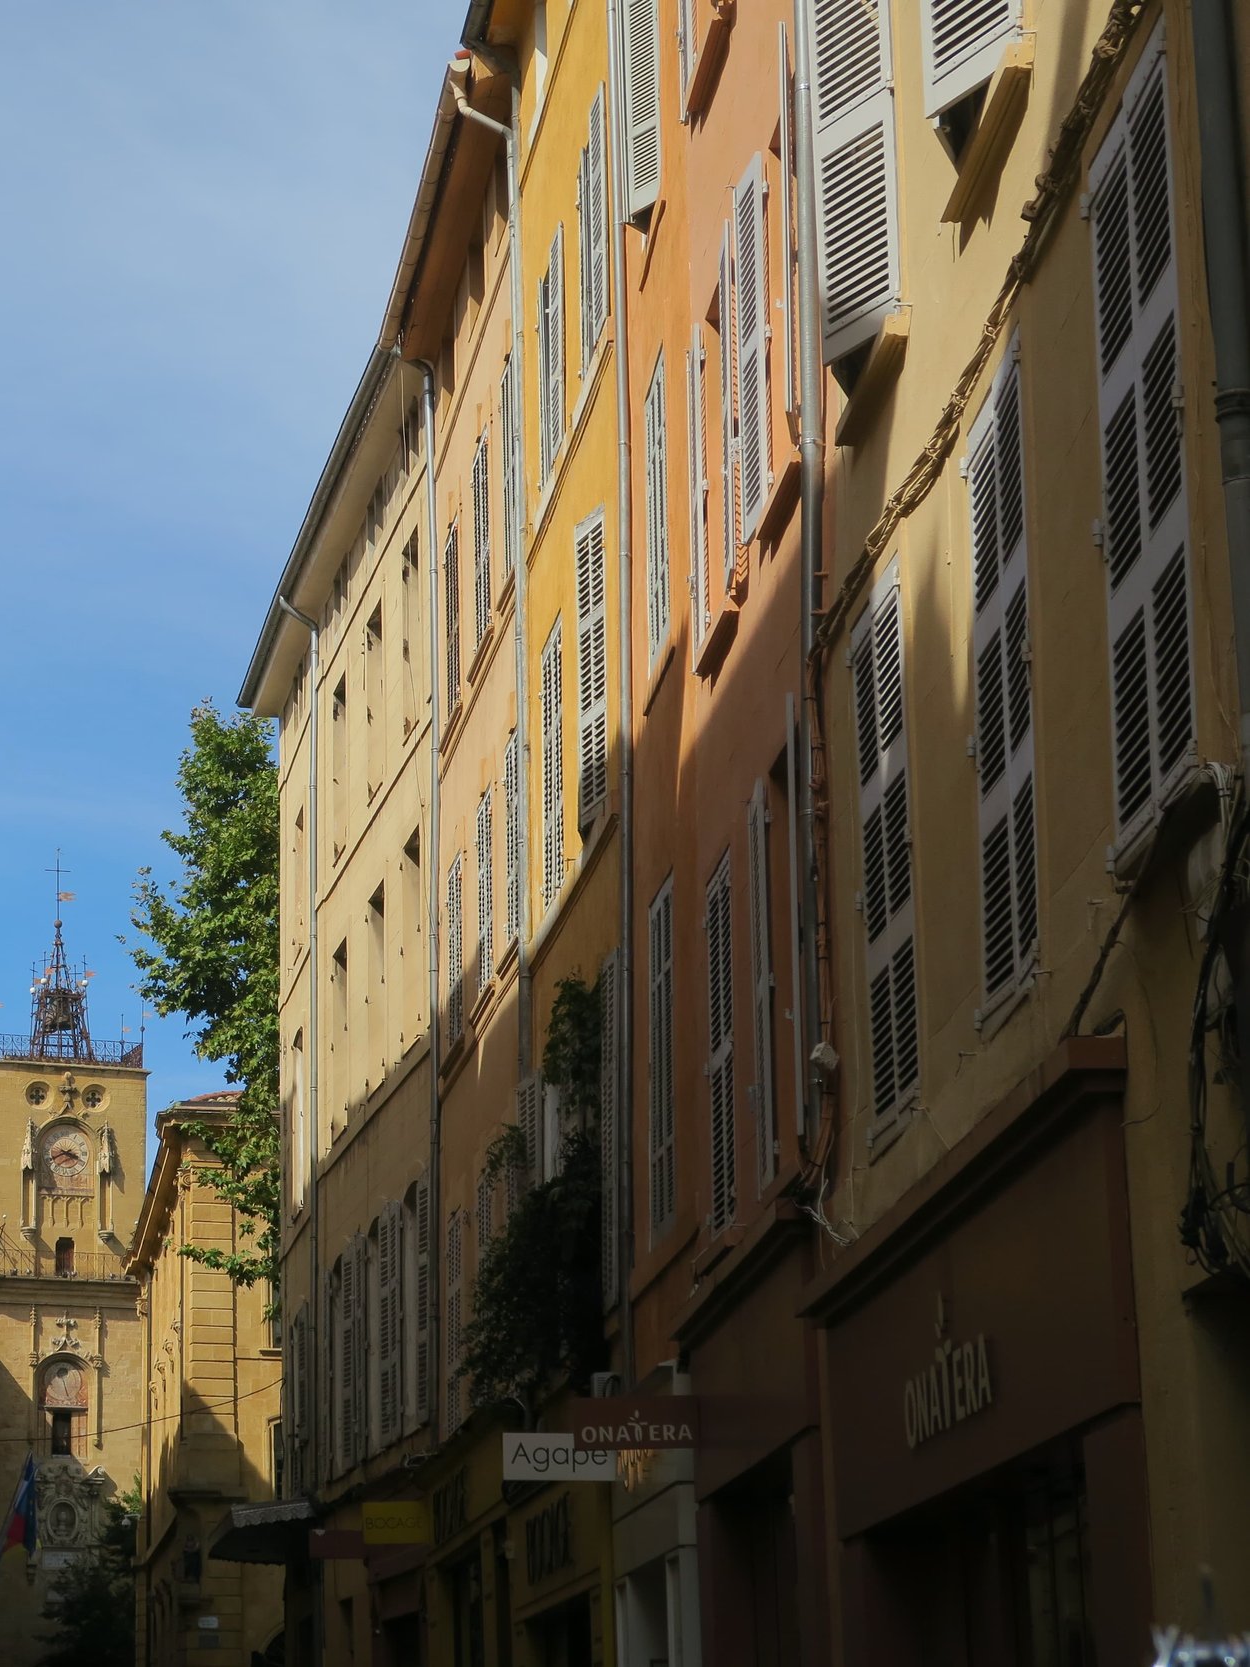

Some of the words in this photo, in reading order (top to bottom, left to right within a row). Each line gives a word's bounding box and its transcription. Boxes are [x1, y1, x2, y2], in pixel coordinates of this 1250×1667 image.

[905, 1333, 993, 1450] ONATERA
[582, 1415, 693, 1443] ONATERA
[511, 1442, 608, 1472] Agape
[365, 1516, 423, 1530] BOCAGE
